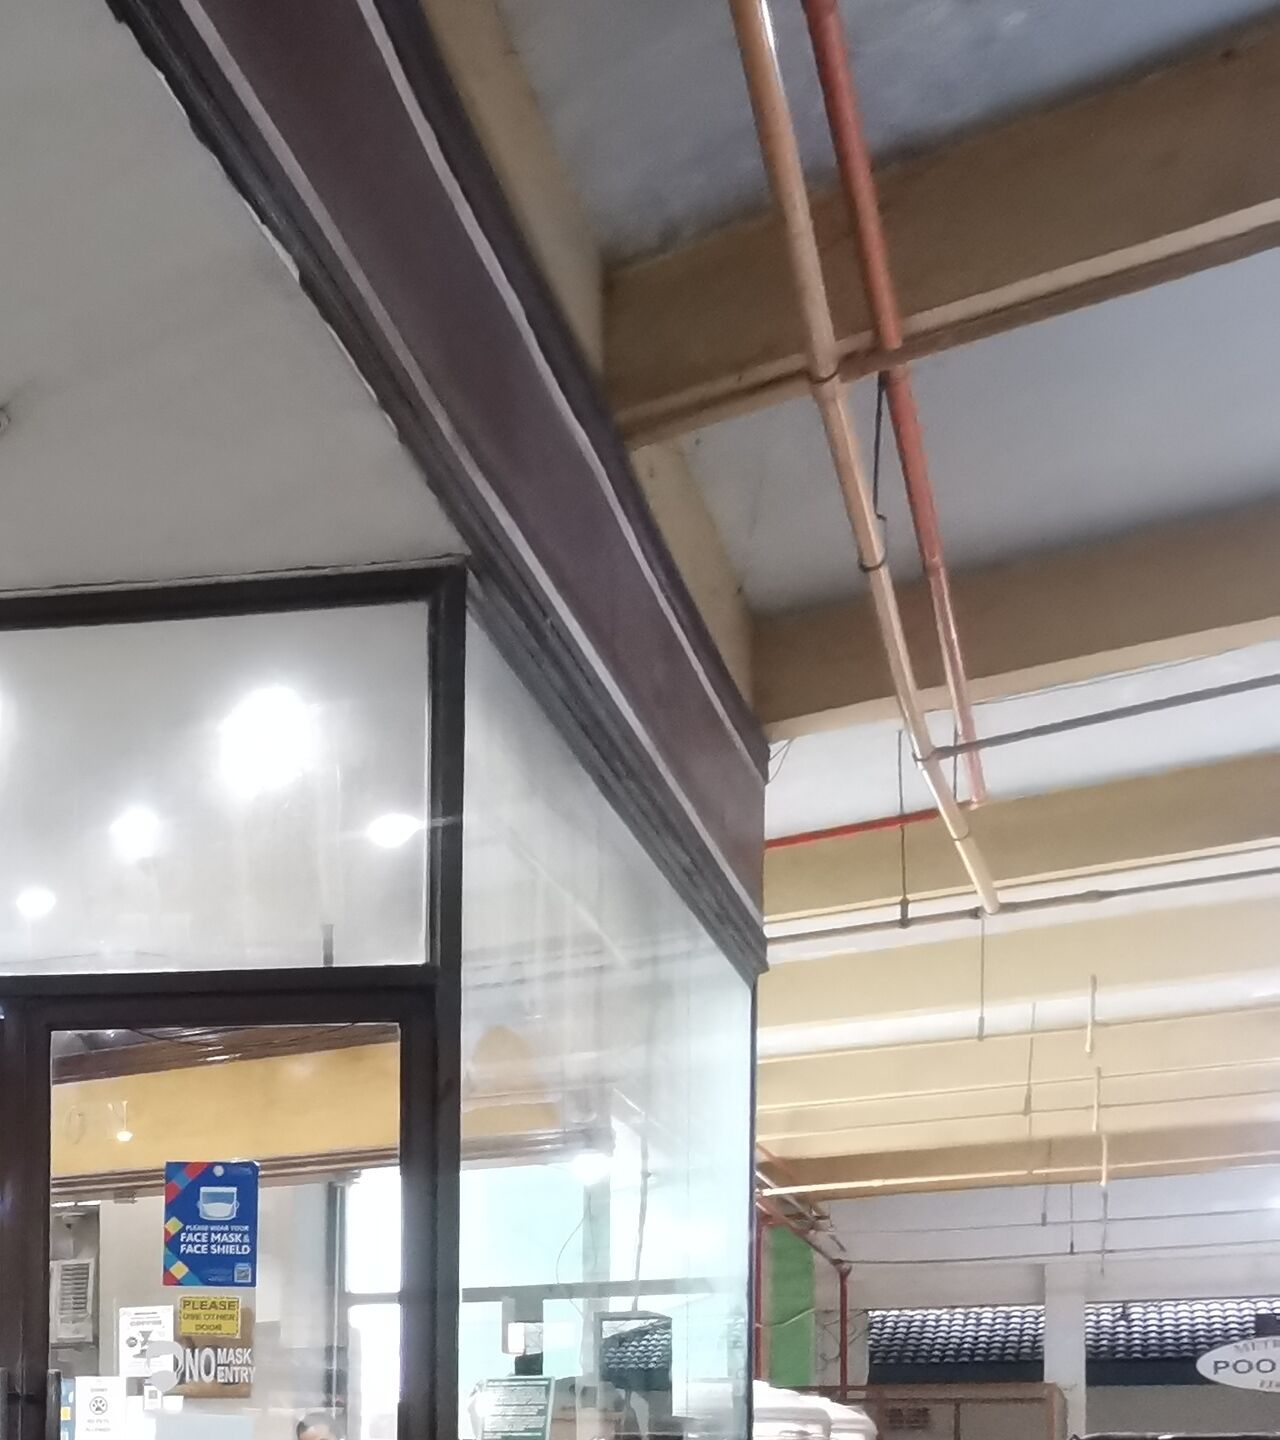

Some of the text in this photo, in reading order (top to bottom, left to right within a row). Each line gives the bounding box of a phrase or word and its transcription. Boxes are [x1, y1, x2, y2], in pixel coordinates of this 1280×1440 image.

[180, 1232, 209, 1243] FACE
[210, 1232, 242, 1243] MASK
[180, 1244, 252, 1255] FACE SHIELD
[182, 1300, 237, 1310] PLEASE
[194, 1323, 223, 1331] DOOR
[217, 1347, 252, 1365] MASK
[185, 1347, 217, 1383] NO
[217, 1366, 257, 1383] ENTRY
